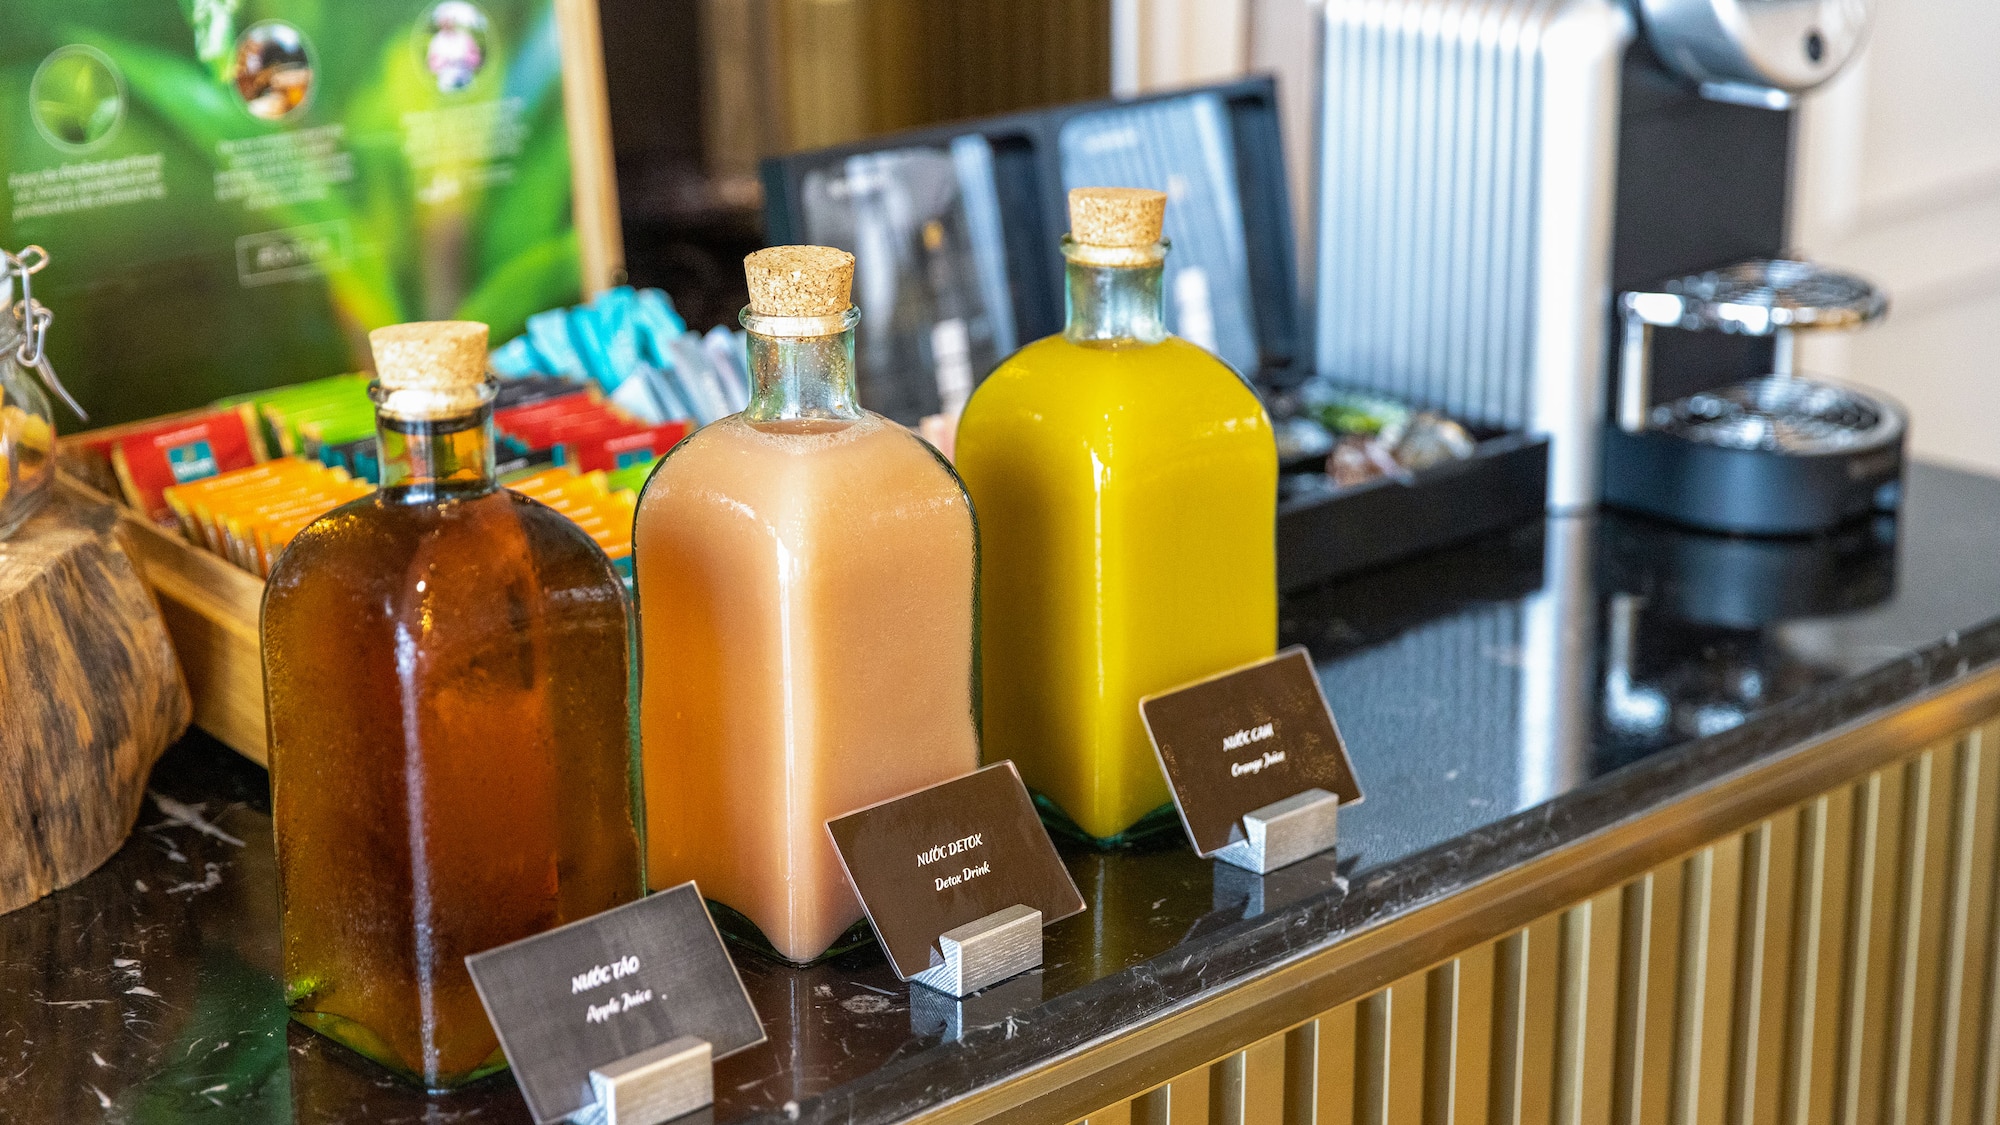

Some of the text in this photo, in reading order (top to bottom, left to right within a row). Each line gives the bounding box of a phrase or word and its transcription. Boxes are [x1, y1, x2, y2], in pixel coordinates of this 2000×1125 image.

[1231, 751, 1286, 777] Orange Juice
[948, 832, 983, 856] DETOX
[935, 861, 991, 891] Detox Drink
[586, 989, 652, 1024] Apple Juice
